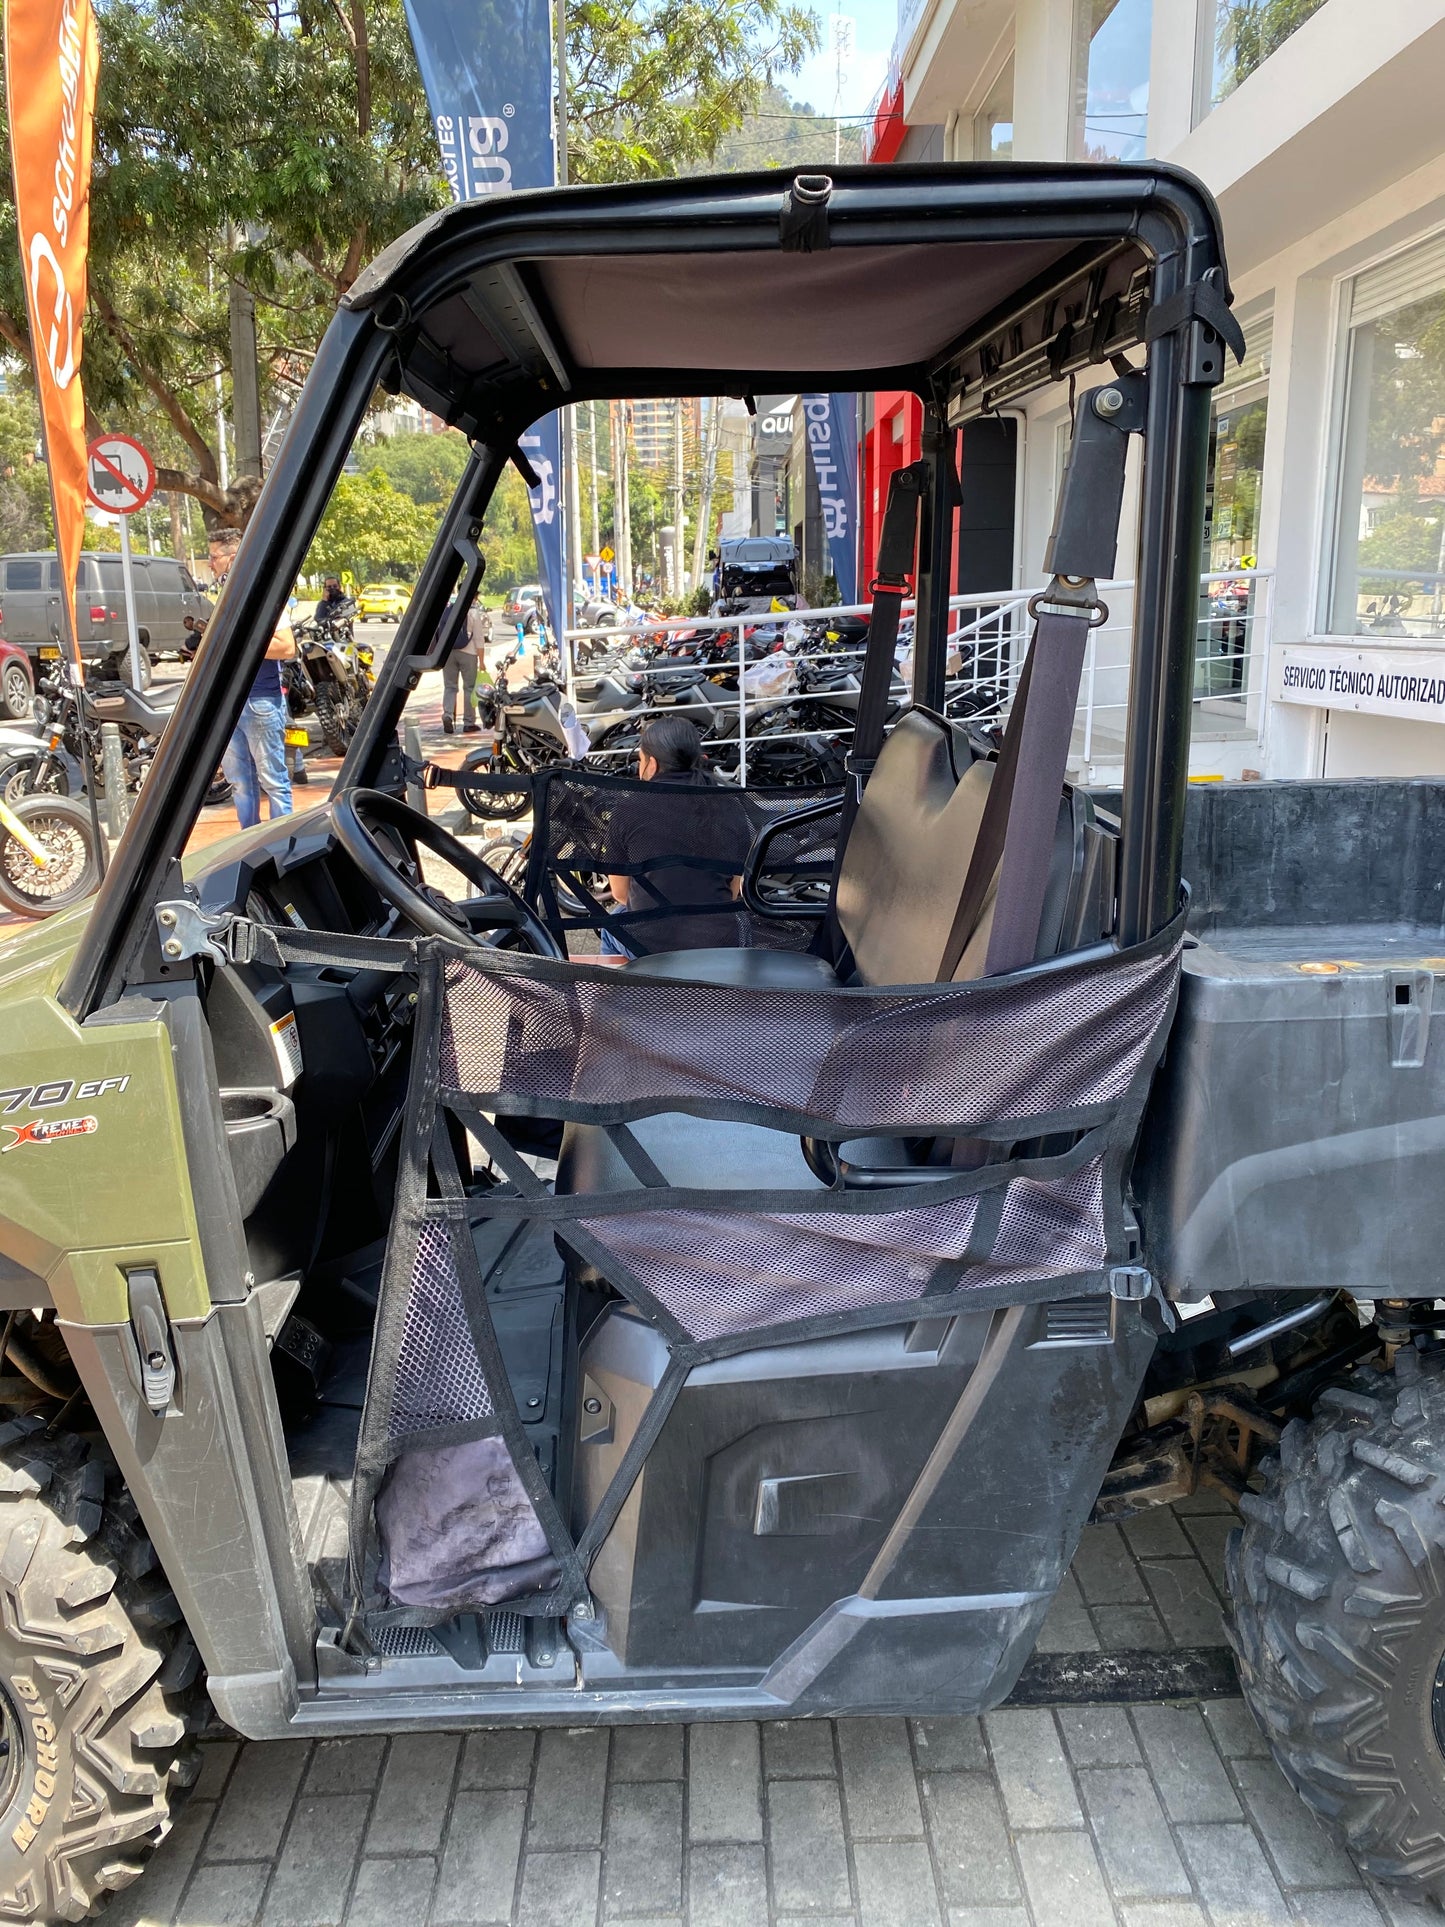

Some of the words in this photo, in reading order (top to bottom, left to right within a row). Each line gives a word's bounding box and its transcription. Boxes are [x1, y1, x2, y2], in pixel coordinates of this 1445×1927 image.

[52, 0, 81, 249] SCHUBER
[1283, 665, 1326, 690] SERVICIO
[1329, 664, 1374, 696] TÉCNICO
[75, 1075, 131, 1099] EFI
[10, 1674, 58, 1853] BIGHORN
